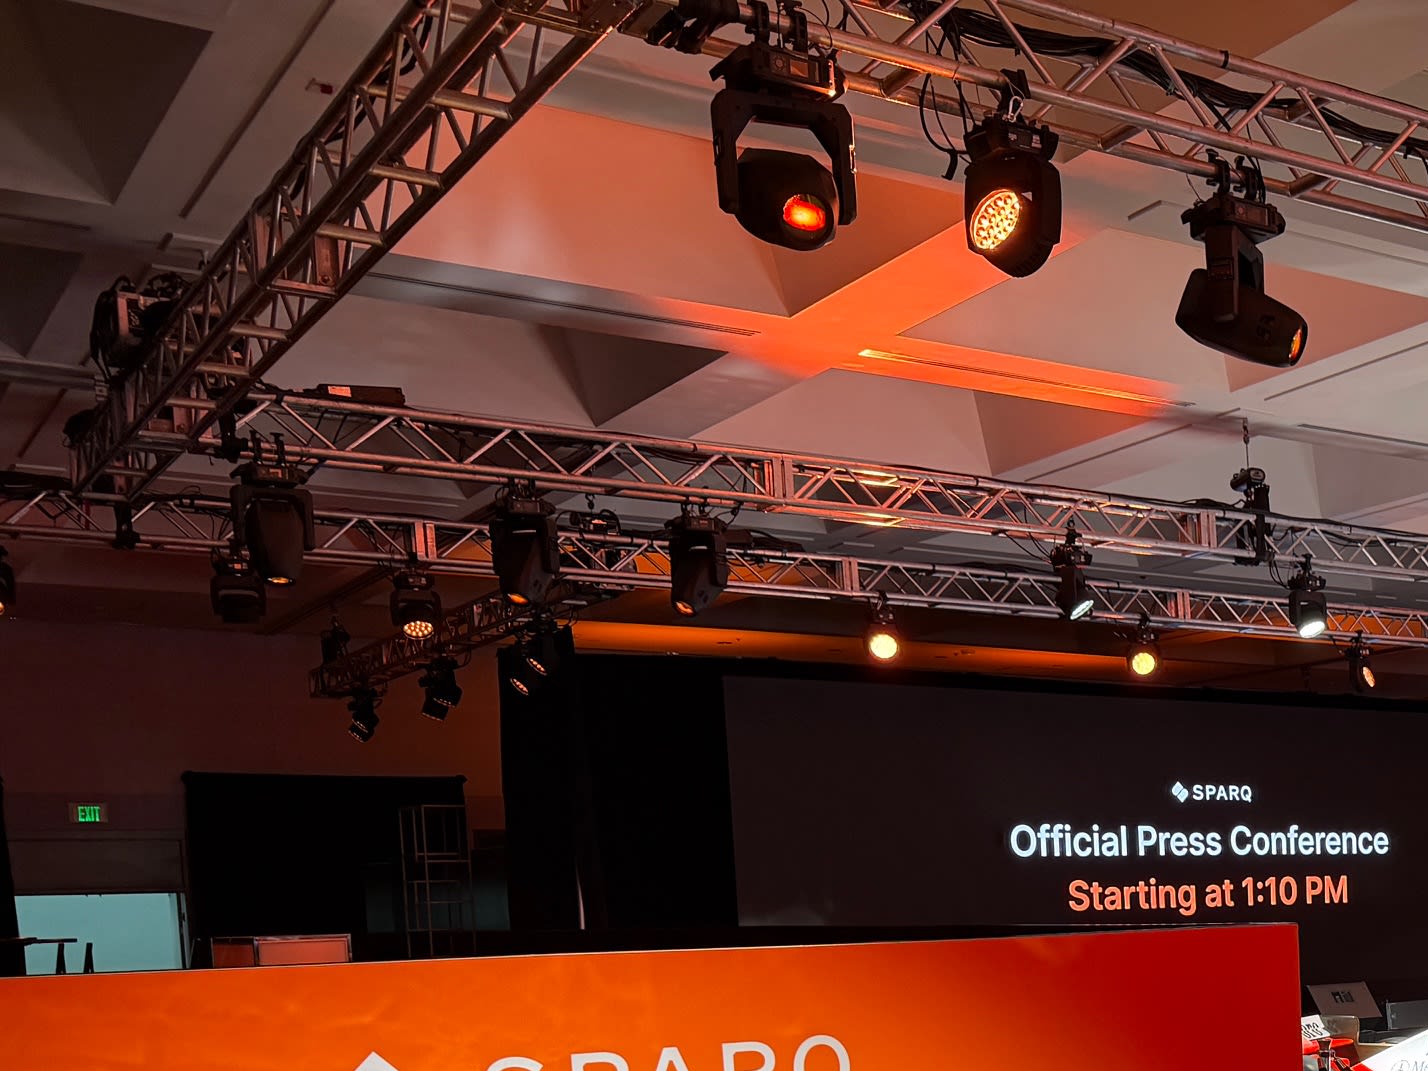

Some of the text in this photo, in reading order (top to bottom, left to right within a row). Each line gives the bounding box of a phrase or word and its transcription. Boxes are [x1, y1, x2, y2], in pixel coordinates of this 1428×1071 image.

[1191, 784, 1252, 803] SPARQ
[78, 806, 100, 822] EXIT
[1010, 823, 1389, 858] Official Press Conference
[1068, 875, 1349, 917] Starting at 1:10 PM
